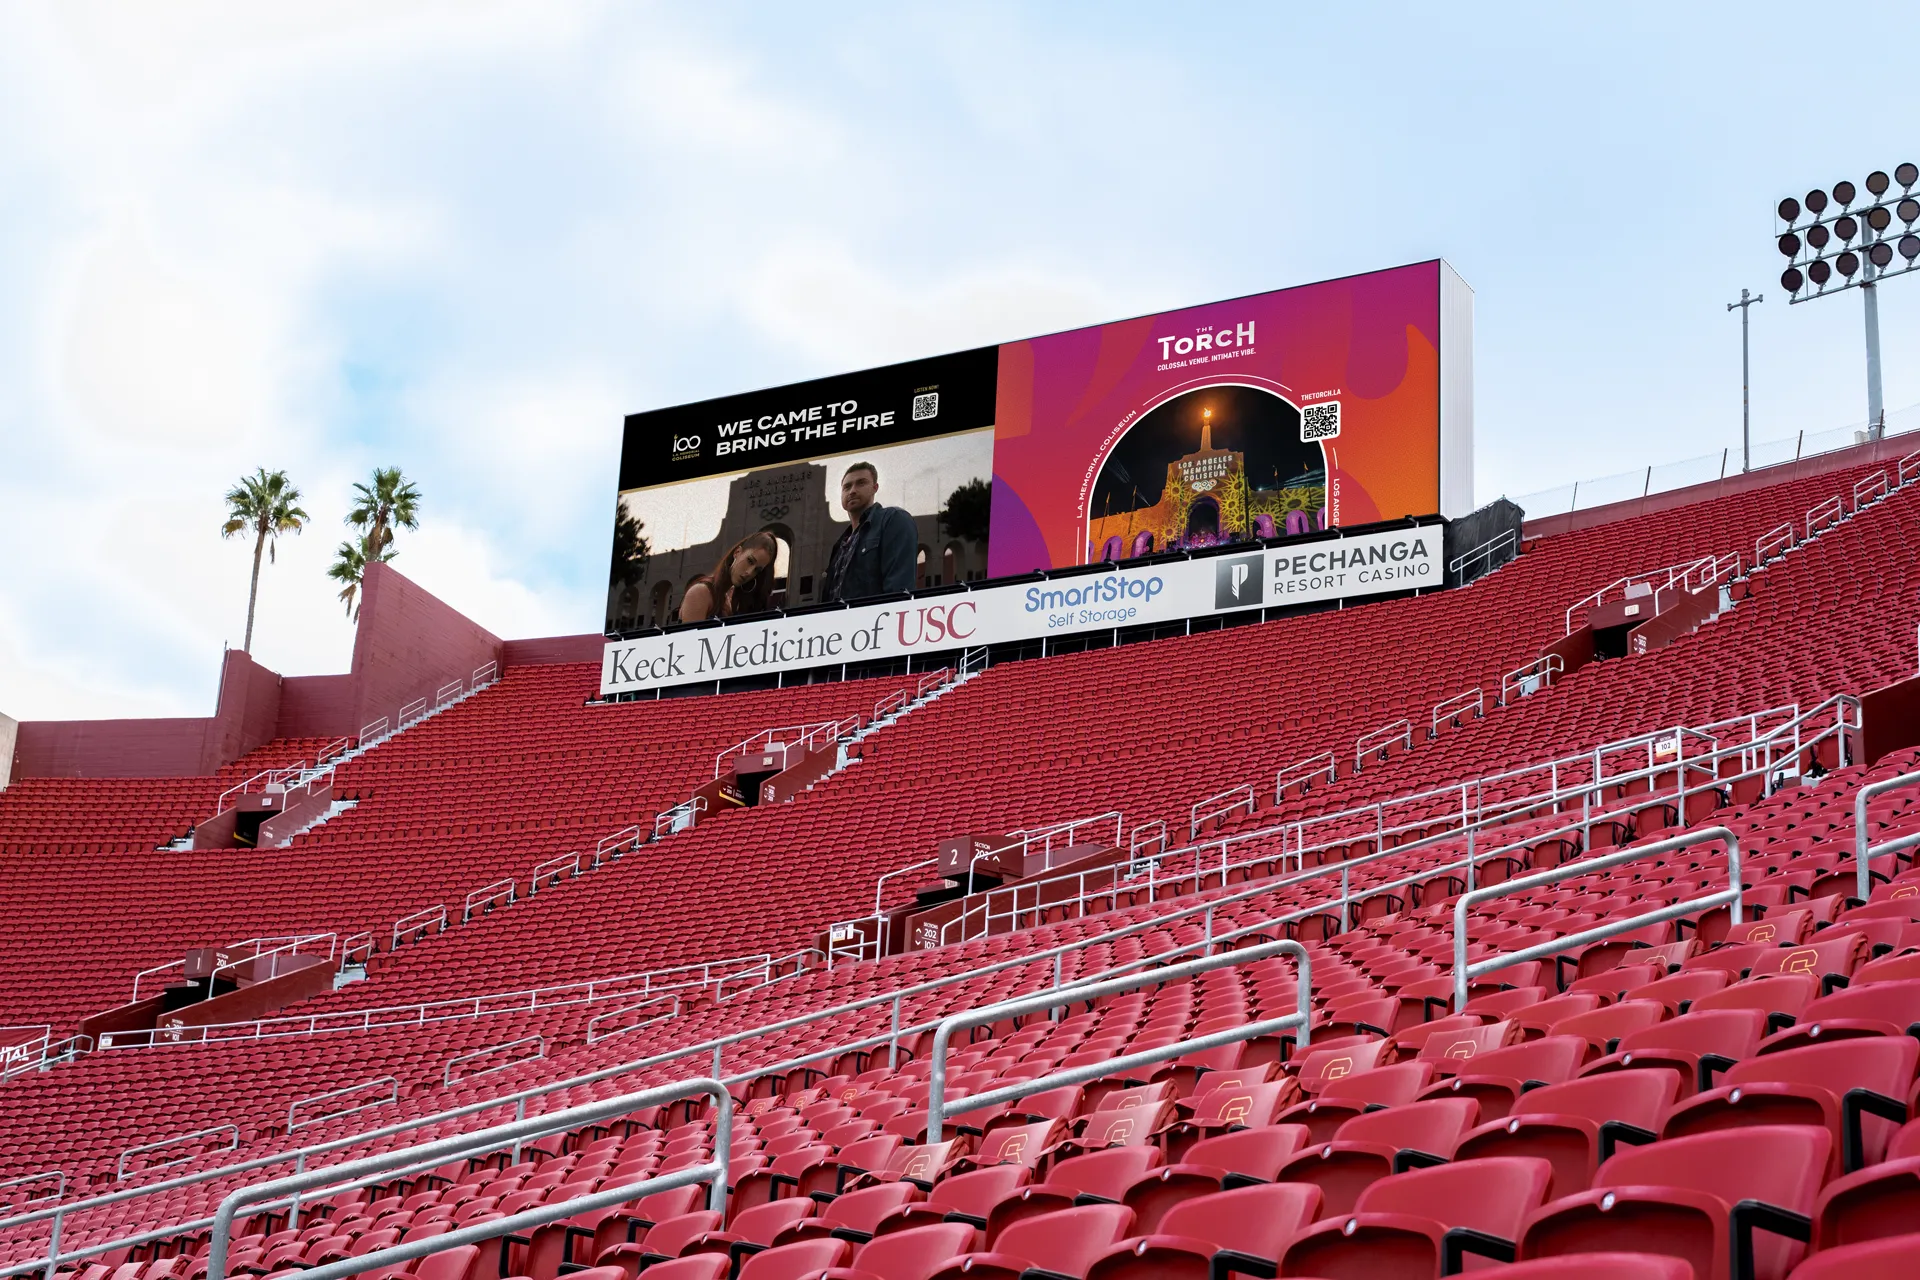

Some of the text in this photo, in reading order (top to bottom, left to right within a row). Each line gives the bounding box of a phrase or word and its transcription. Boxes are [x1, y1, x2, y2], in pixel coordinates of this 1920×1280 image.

[1157, 320, 1255, 360] TORCH
[1157, 347, 1256, 371] COLOSSAL VENUE. INTIMATE VIBE.
[1301, 388, 1341, 401] THETORCH.LA
[717, 400, 858, 437] WE CAME TO
[716, 411, 895, 456] BRING THE FIRE
[1079, 452, 1103, 500] MEMORIAL
[1100, 410, 1137, 451] COLISEUM
[1178, 455, 1233, 470] LOS ANGELES
[1183, 464, 1227, 475] MEMORIAL
[1184, 470, 1226, 482] COLISEUM
[1274, 538, 1429, 578] PECHANGA
[1274, 562, 1430, 595] RESORT CASINO
[1025, 576, 1163, 612] SmartStop
[1048, 607, 1137, 628] Self Storage
[608, 601, 977, 685] Keck Medicine of USC
[950, 849, 958, 866] 2
[974, 841, 990, 850] SECTION
[924, 928, 937, 939] 202
